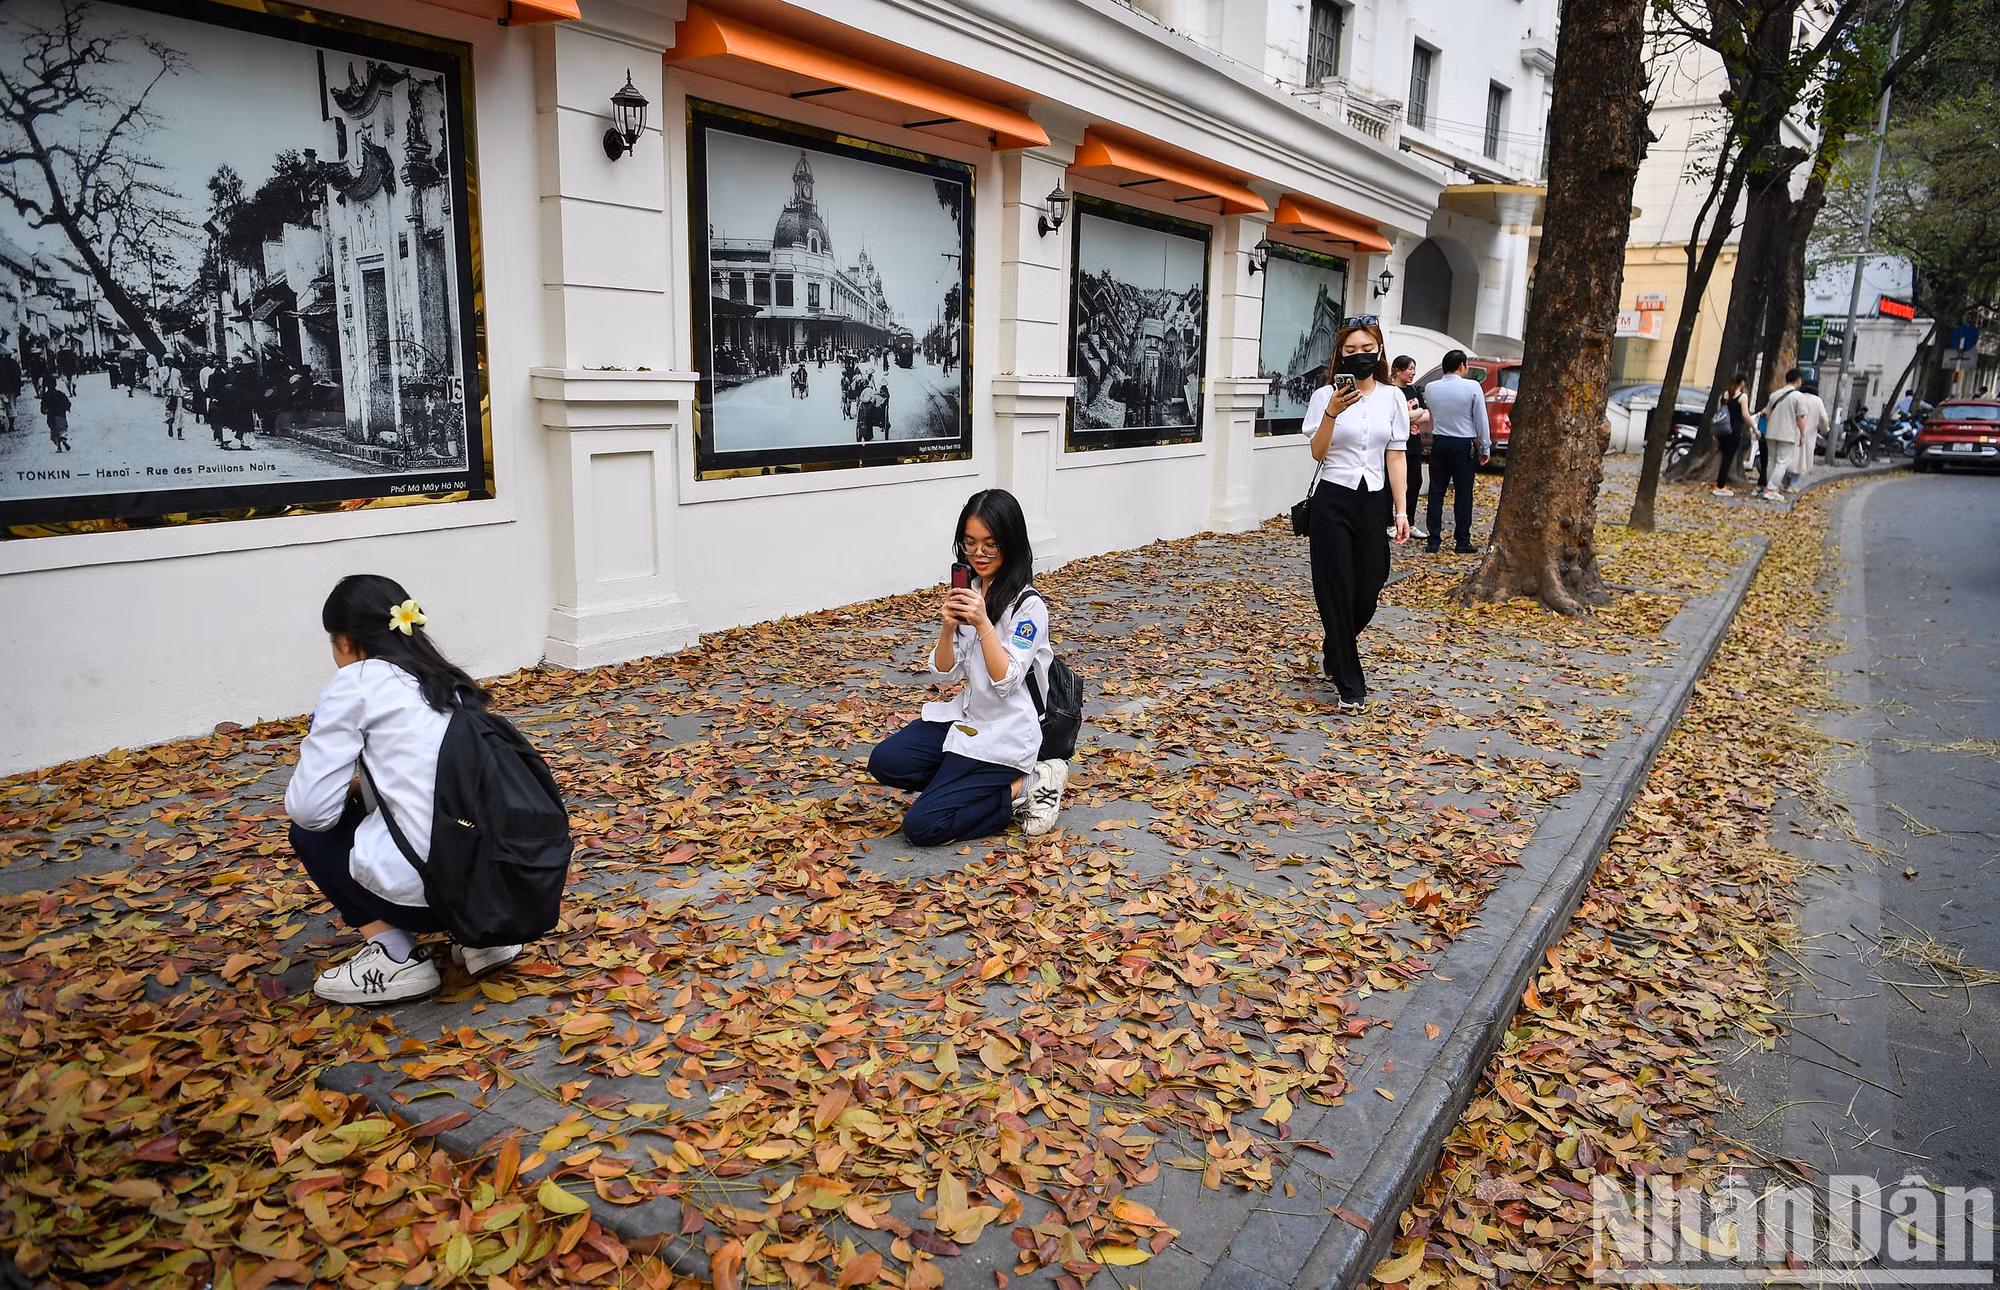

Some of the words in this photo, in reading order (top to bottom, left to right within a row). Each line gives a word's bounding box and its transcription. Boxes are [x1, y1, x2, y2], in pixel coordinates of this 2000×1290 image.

[1643, 301, 1661, 310] ATM
[17, 470, 71, 481] TONKIN
[96, 467, 130, 478] Hanoï
[146, 467, 168, 476] Rue
[173, 466, 193, 475] des
[198, 464, 245, 473] Pavillons
[249, 462, 276, 471] Noirs
[390, 484, 407, 494] Phố
[441, 481, 452, 490] Hà
[453, 480, 467, 489] Nội
[361, 967, 387, 995] NY
